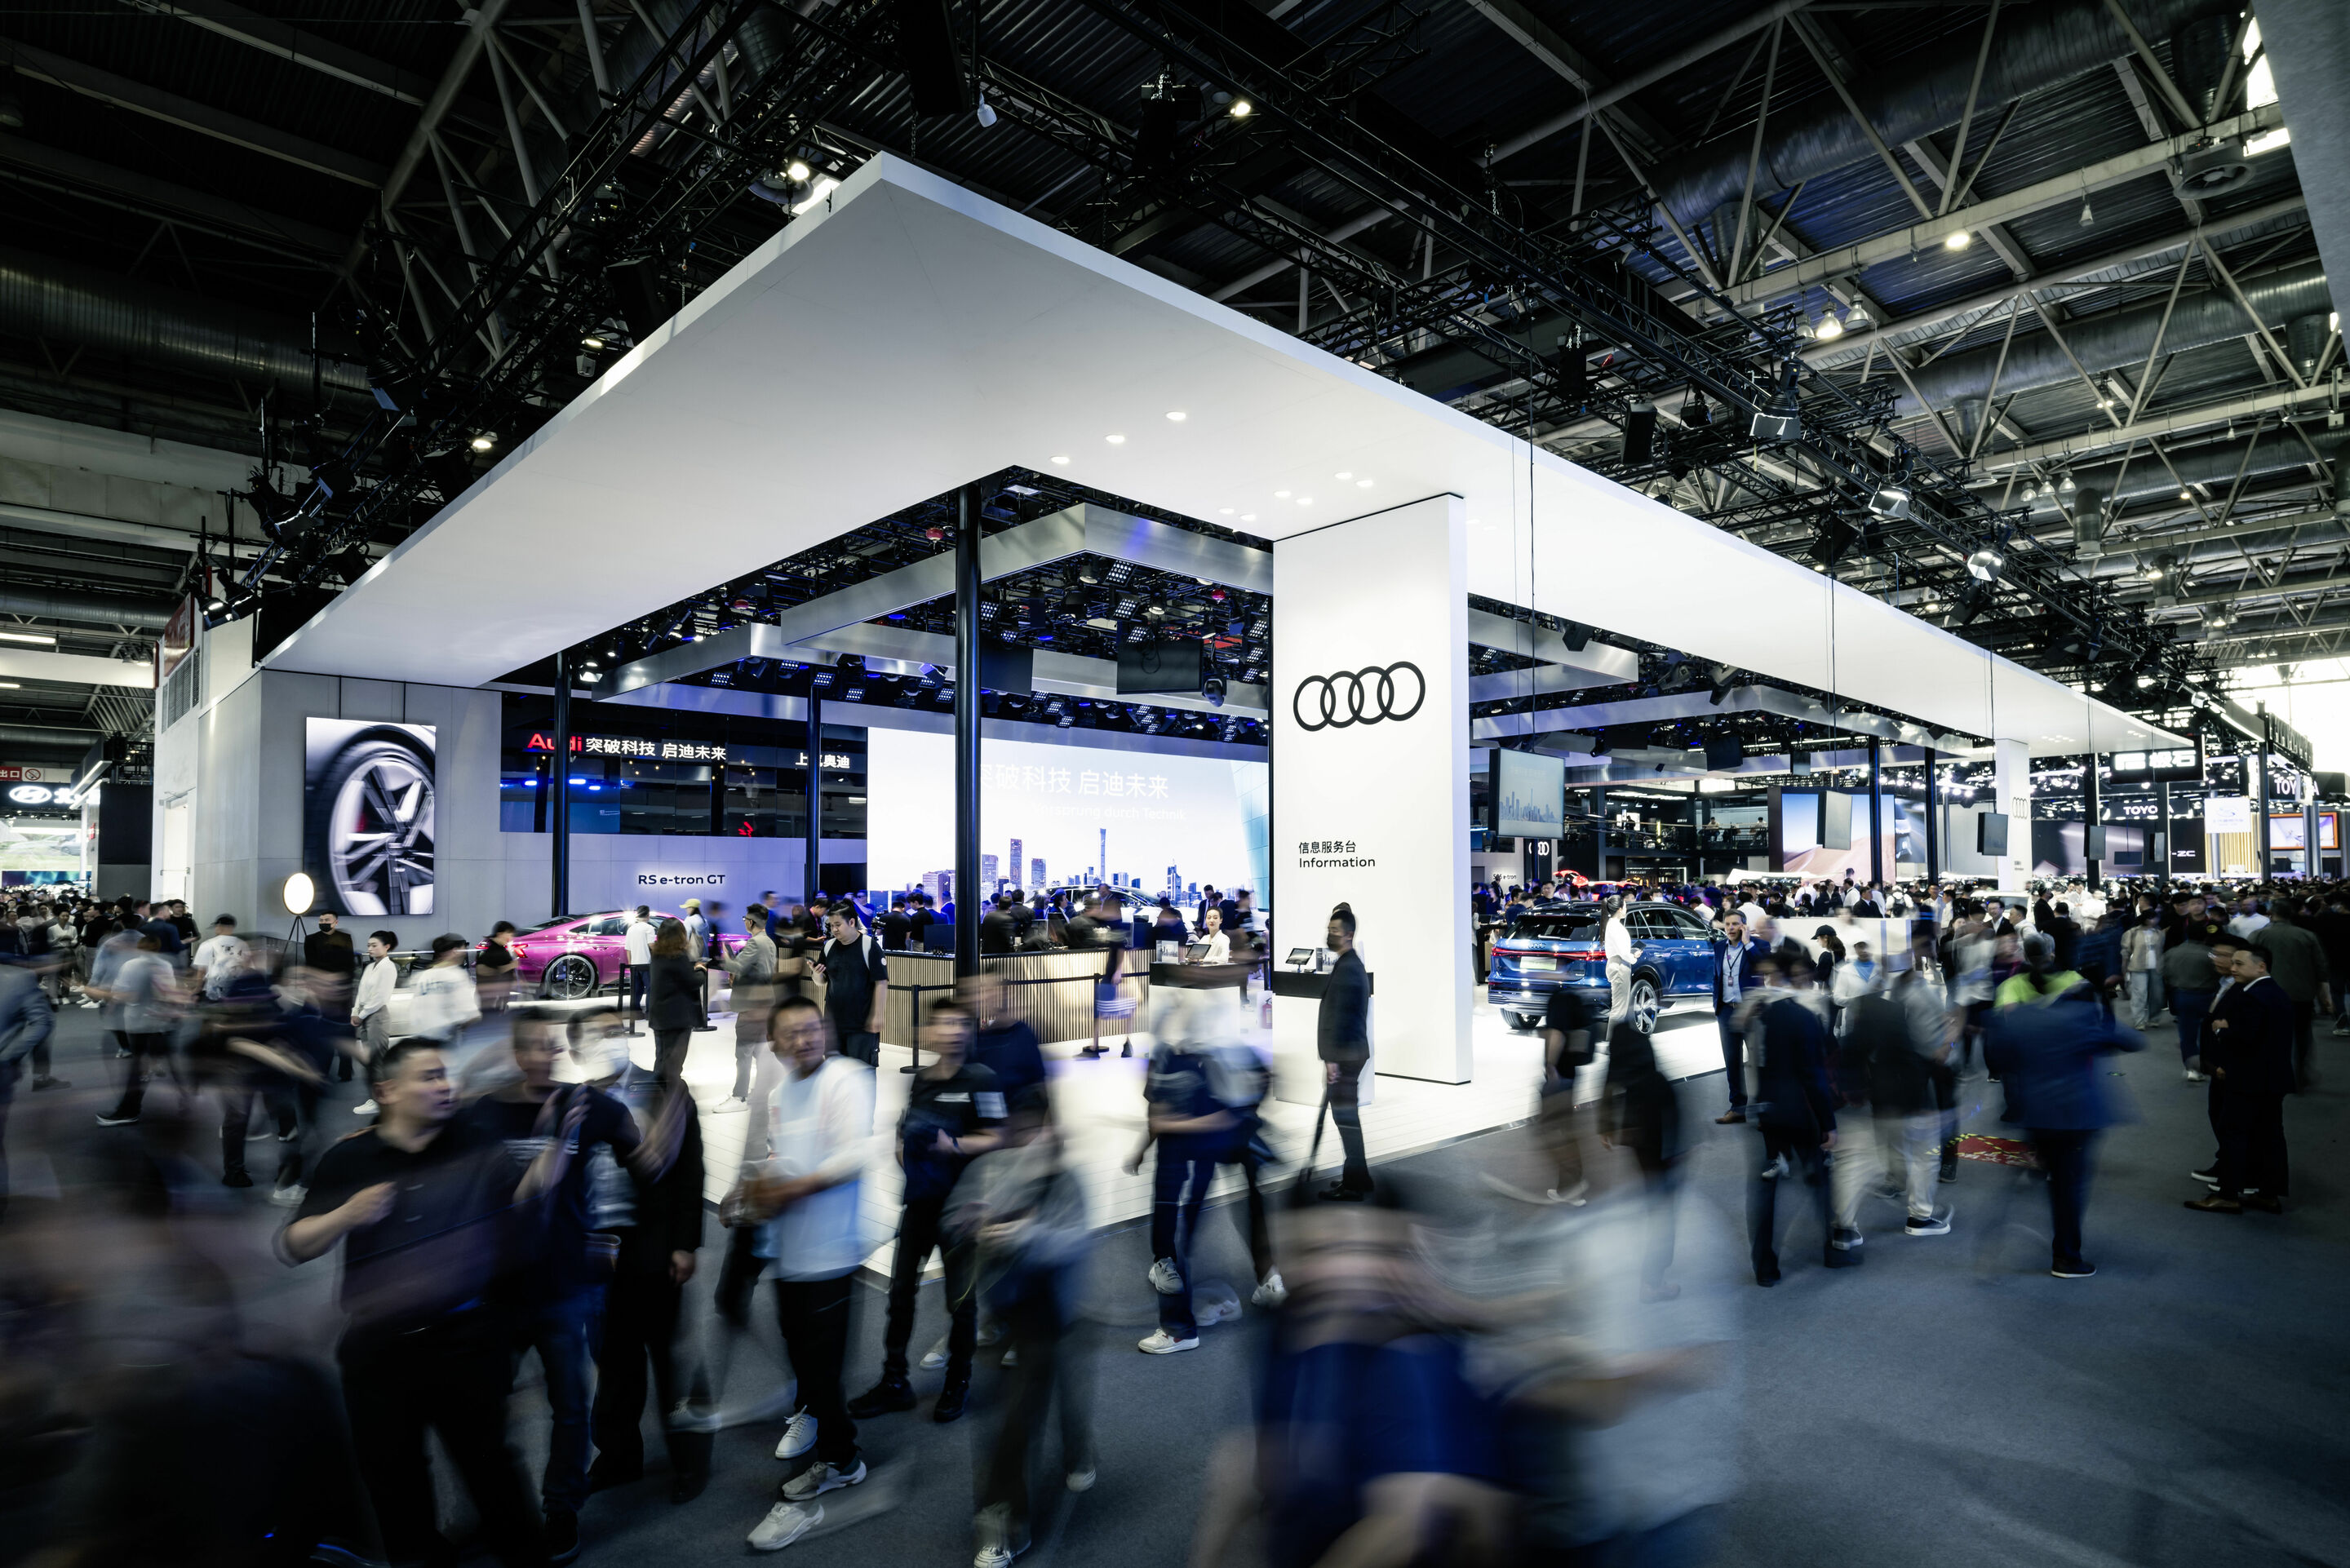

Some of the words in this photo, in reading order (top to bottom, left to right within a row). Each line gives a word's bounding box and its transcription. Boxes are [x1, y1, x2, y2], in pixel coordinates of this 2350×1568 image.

[585, 737, 656, 757] 突破科技
[662, 742, 726, 760] 启迪未来
[795, 752, 850, 768] 上奥迪
[0, 769, 20, 777] 出口
[1078, 769, 1169, 800] 启迪未来
[2274, 778, 2320, 795] TOYA
[1104, 806, 1140, 818] durch
[2123, 804, 2175, 815] TOYOA
[1299, 840, 1356, 854] 信息服务台
[1299, 857, 1376, 868] Information
[638, 875, 657, 884] RS
[659, 875, 703, 884] e-tron
[707, 875, 725, 884] GT
